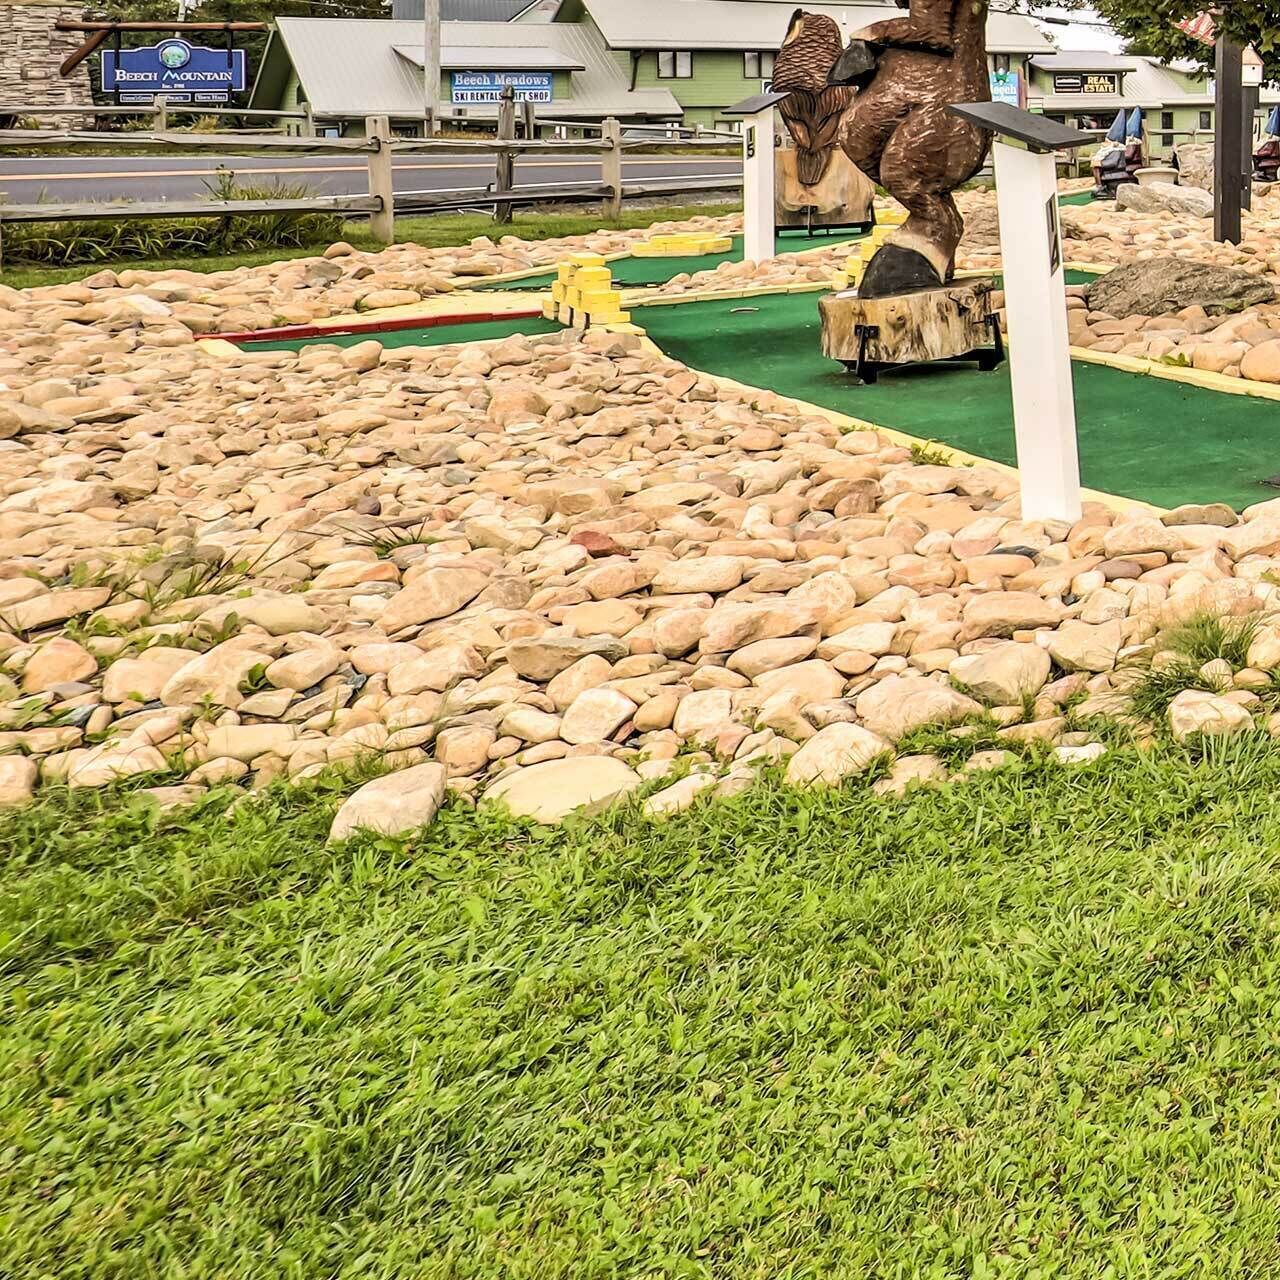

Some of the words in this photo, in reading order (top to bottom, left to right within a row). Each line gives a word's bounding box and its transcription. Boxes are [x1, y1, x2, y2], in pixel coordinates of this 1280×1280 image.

[455, 73, 490, 85] Beech
[495, 73, 549, 85] Meadows
[1087, 76, 1111, 84] REAL
[1084, 84, 1114, 93] ESTATE
[455, 92, 468, 101] SKI
[514, 92, 526, 100] IFT
[528, 91, 549, 101] SHOP
